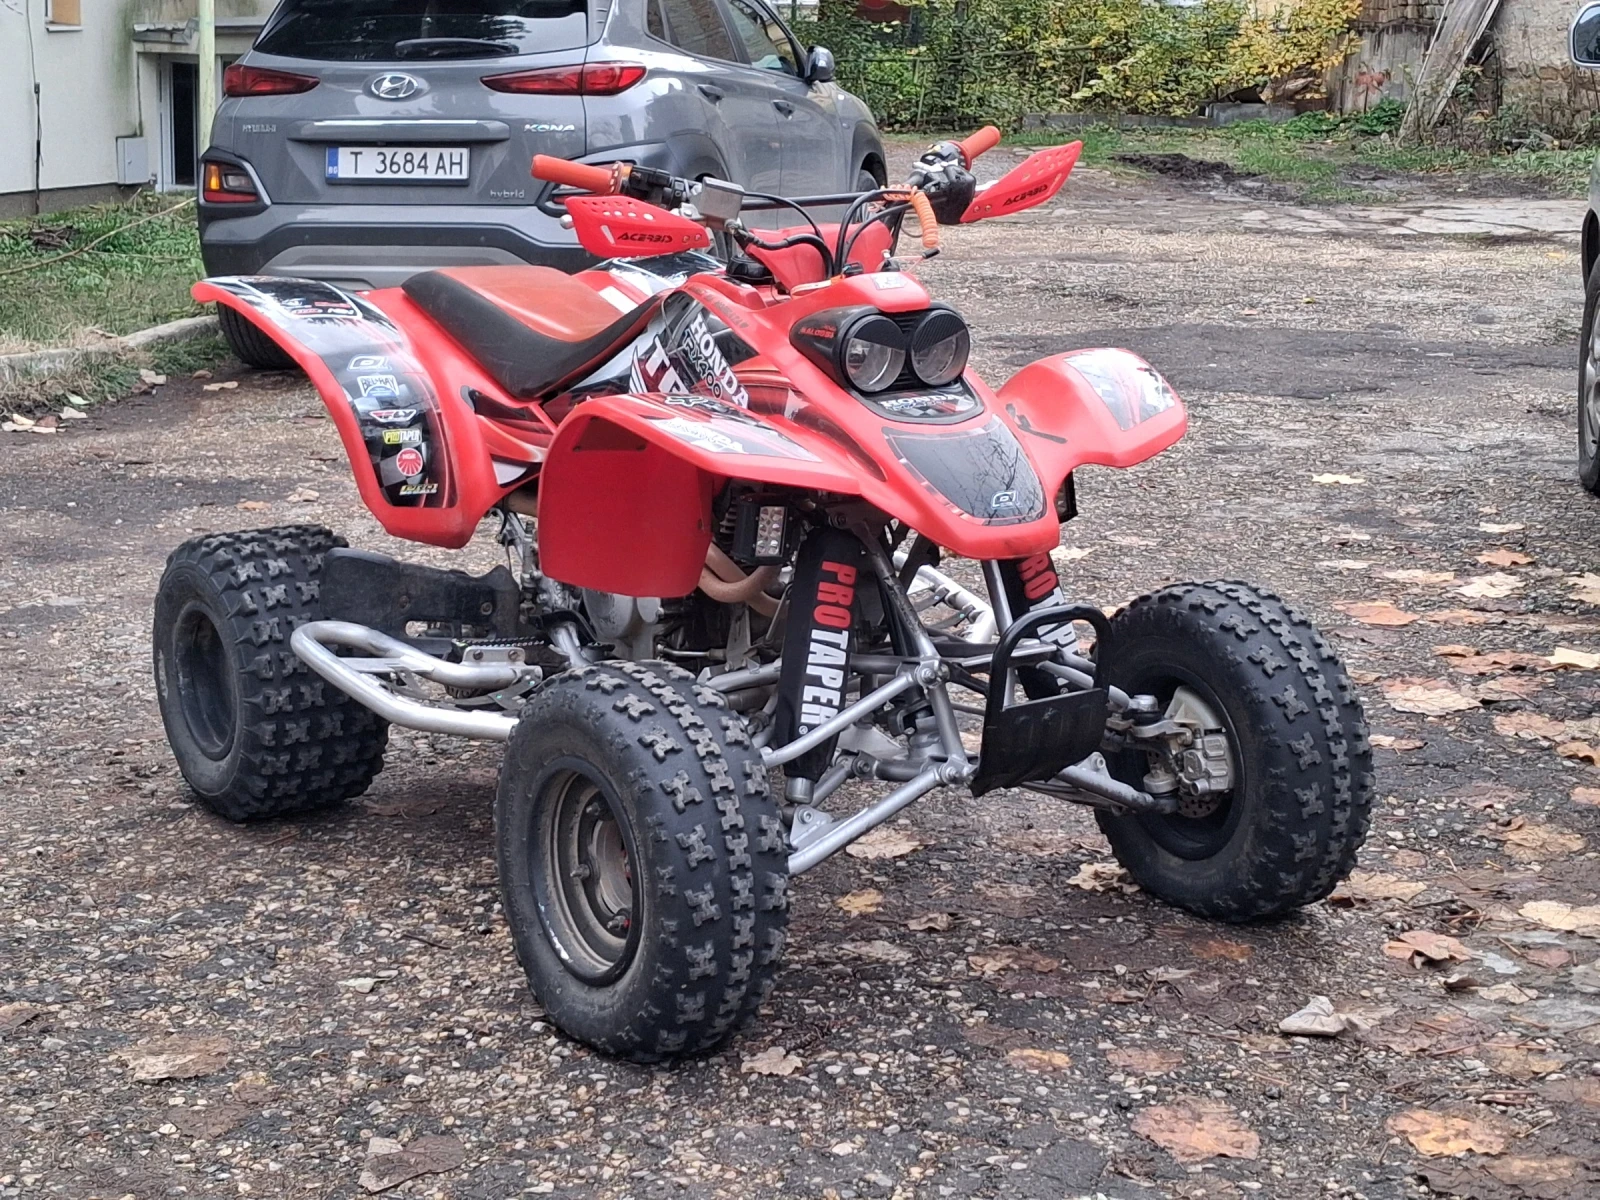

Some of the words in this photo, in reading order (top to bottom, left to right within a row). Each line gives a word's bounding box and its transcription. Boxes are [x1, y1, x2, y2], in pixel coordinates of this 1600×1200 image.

[524, 124, 575, 132] KONA
[350, 151, 363, 174] T
[375, 151, 429, 174] 3684
[435, 151, 463, 175] AH
[490, 189, 525, 199] hybrid
[1003, 184, 1048, 206] ACERBIS
[617, 232, 673, 244] ACERBIS
[691, 312, 749, 409] HONDA
